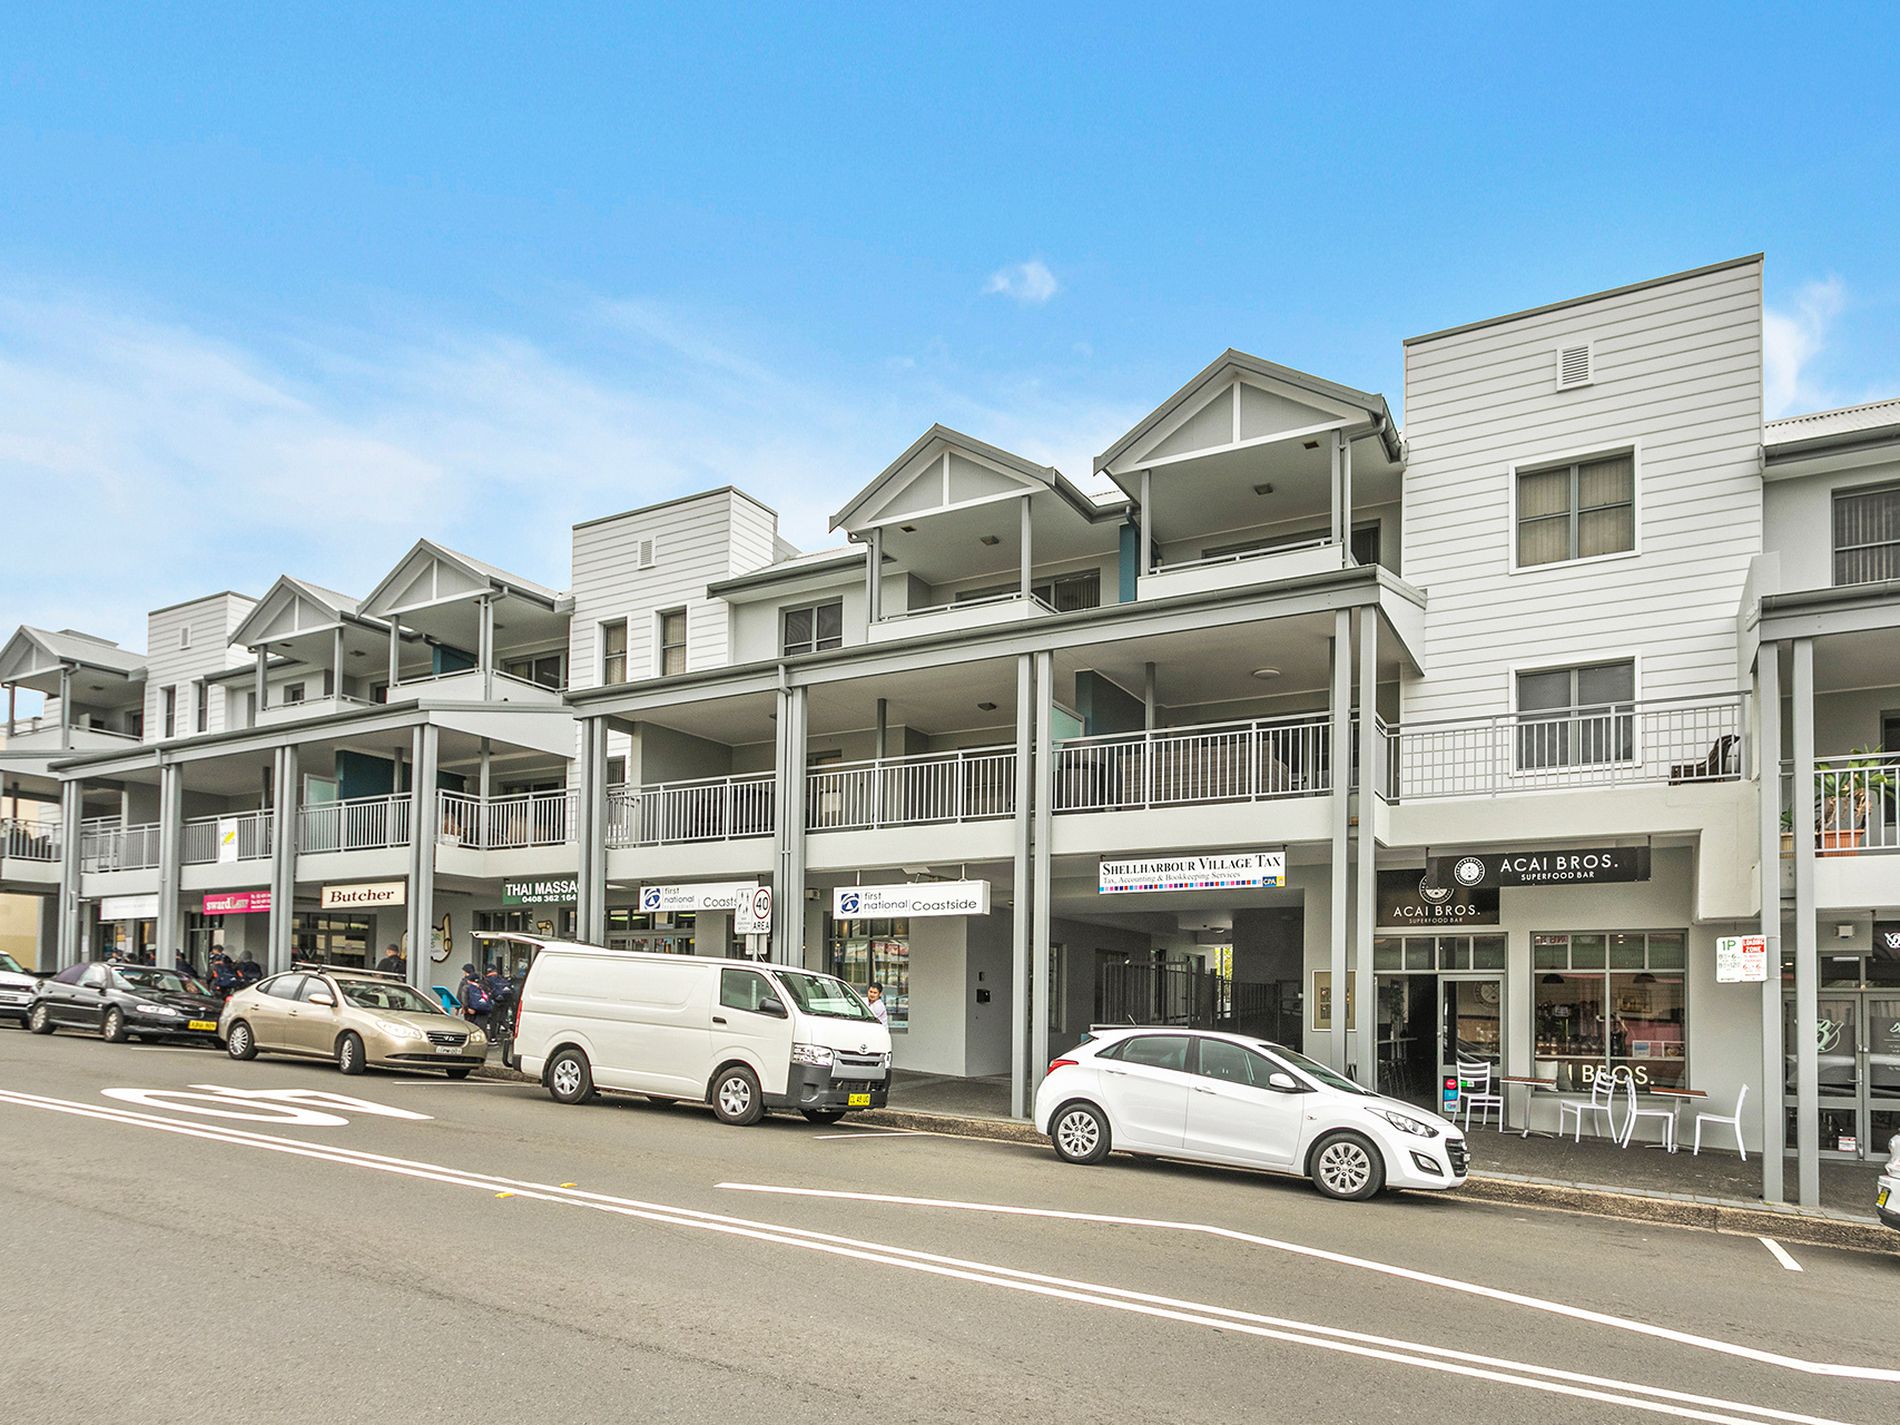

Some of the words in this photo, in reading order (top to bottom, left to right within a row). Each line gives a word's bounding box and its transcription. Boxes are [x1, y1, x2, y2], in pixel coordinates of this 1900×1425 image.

[1102, 861, 1196, 876] SHELLHARBOUR
[1199, 857, 1252, 871] VILLAGE
[1255, 854, 1281, 868] TAX
[1500, 857, 1548, 873] ACAI
[1556, 853, 1619, 870] BROS.
[1521, 871, 1575, 881] SUPERFOOD
[1577, 871, 1595, 879] BAR
[505, 883, 532, 896] THAI
[535, 880, 580, 895] MASSA
[664, 887, 680, 895] first
[329, 889, 395, 903] Butcher
[664, 896, 695, 904] national
[703, 897, 738, 908] Coasts
[864, 892, 882, 900] first
[756, 896, 769, 911] 40
[864, 900, 908, 910] national
[911, 899, 977, 912] Coastside
[1393, 906, 1429, 917] ACAI
[1435, 904, 1481, 916] BROS.
[752, 921, 770, 931] AREA
[1722, 939, 1737, 951] 1P
